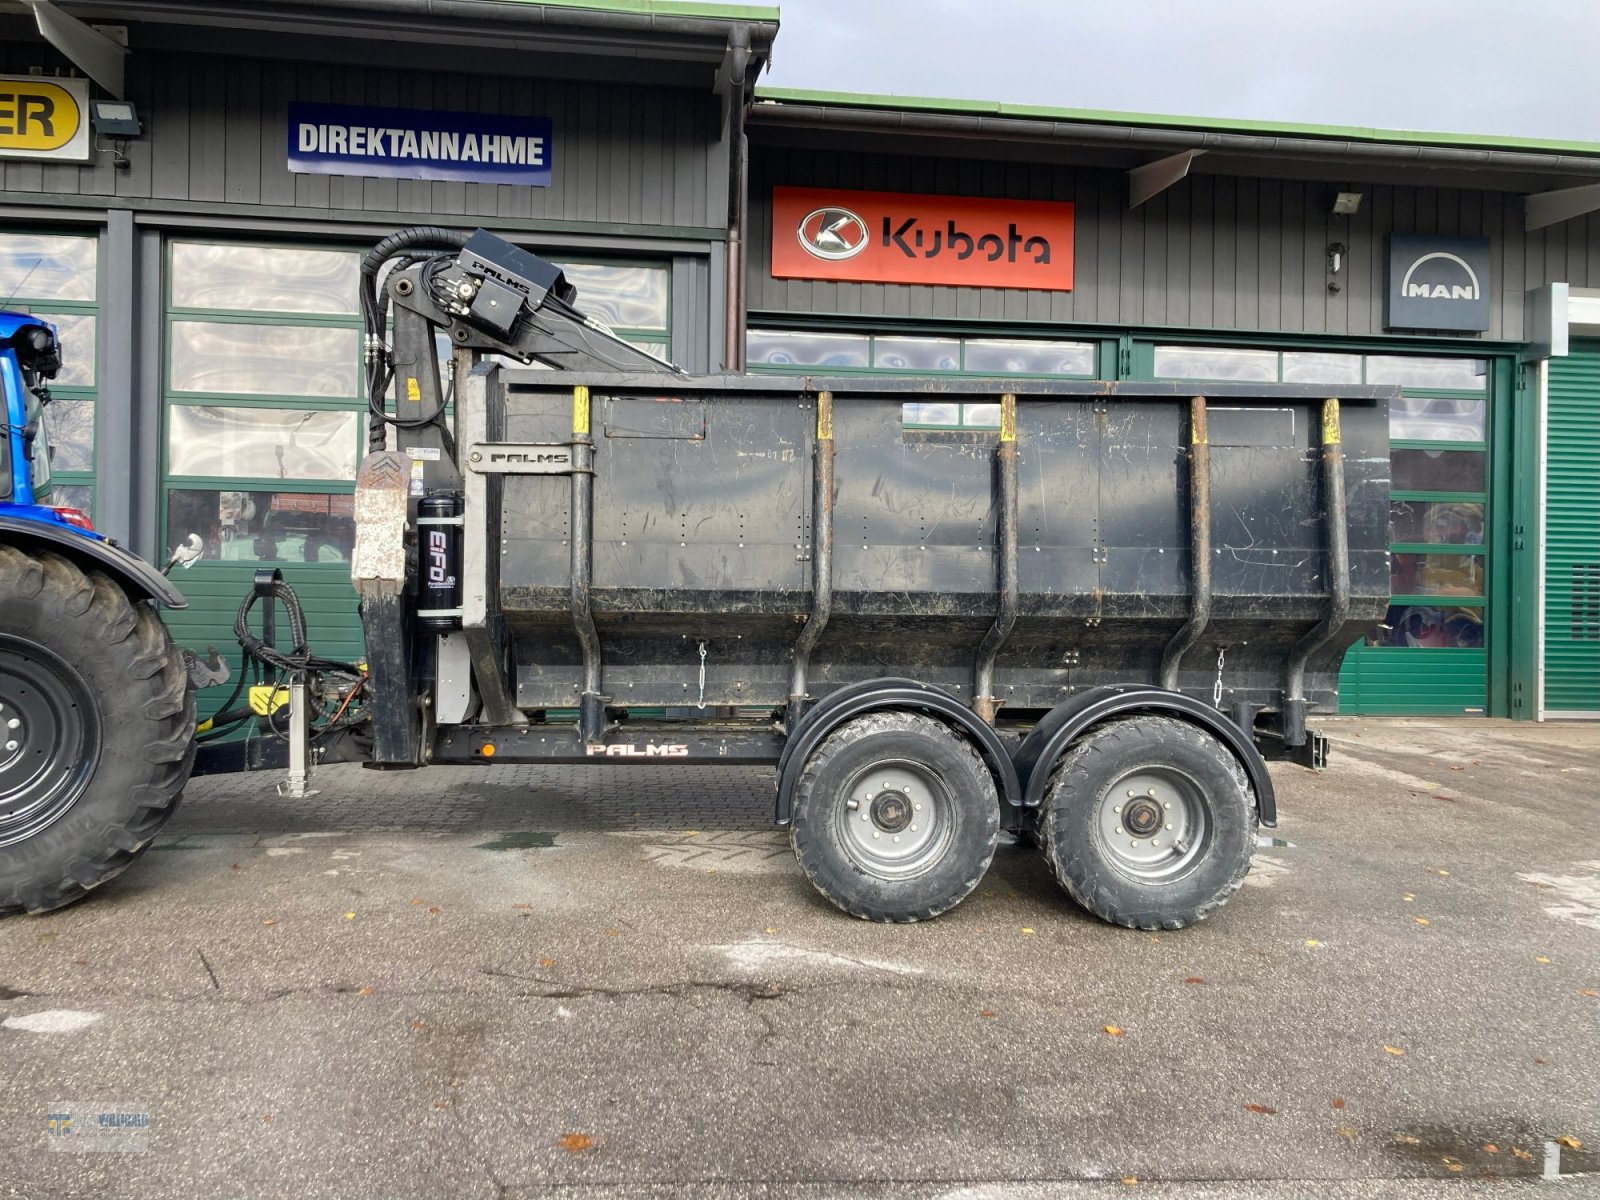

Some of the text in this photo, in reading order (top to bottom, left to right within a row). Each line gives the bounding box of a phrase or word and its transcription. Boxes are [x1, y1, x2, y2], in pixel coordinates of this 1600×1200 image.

[298, 123, 544, 166] DIREKTANNAHME
[882, 216, 1051, 264] Kubota
[472, 260, 531, 295] PALMS
[1409, 283, 1473, 300] MAN
[490, 453, 569, 464] PALMS
[586, 744, 689, 757] PALMS
